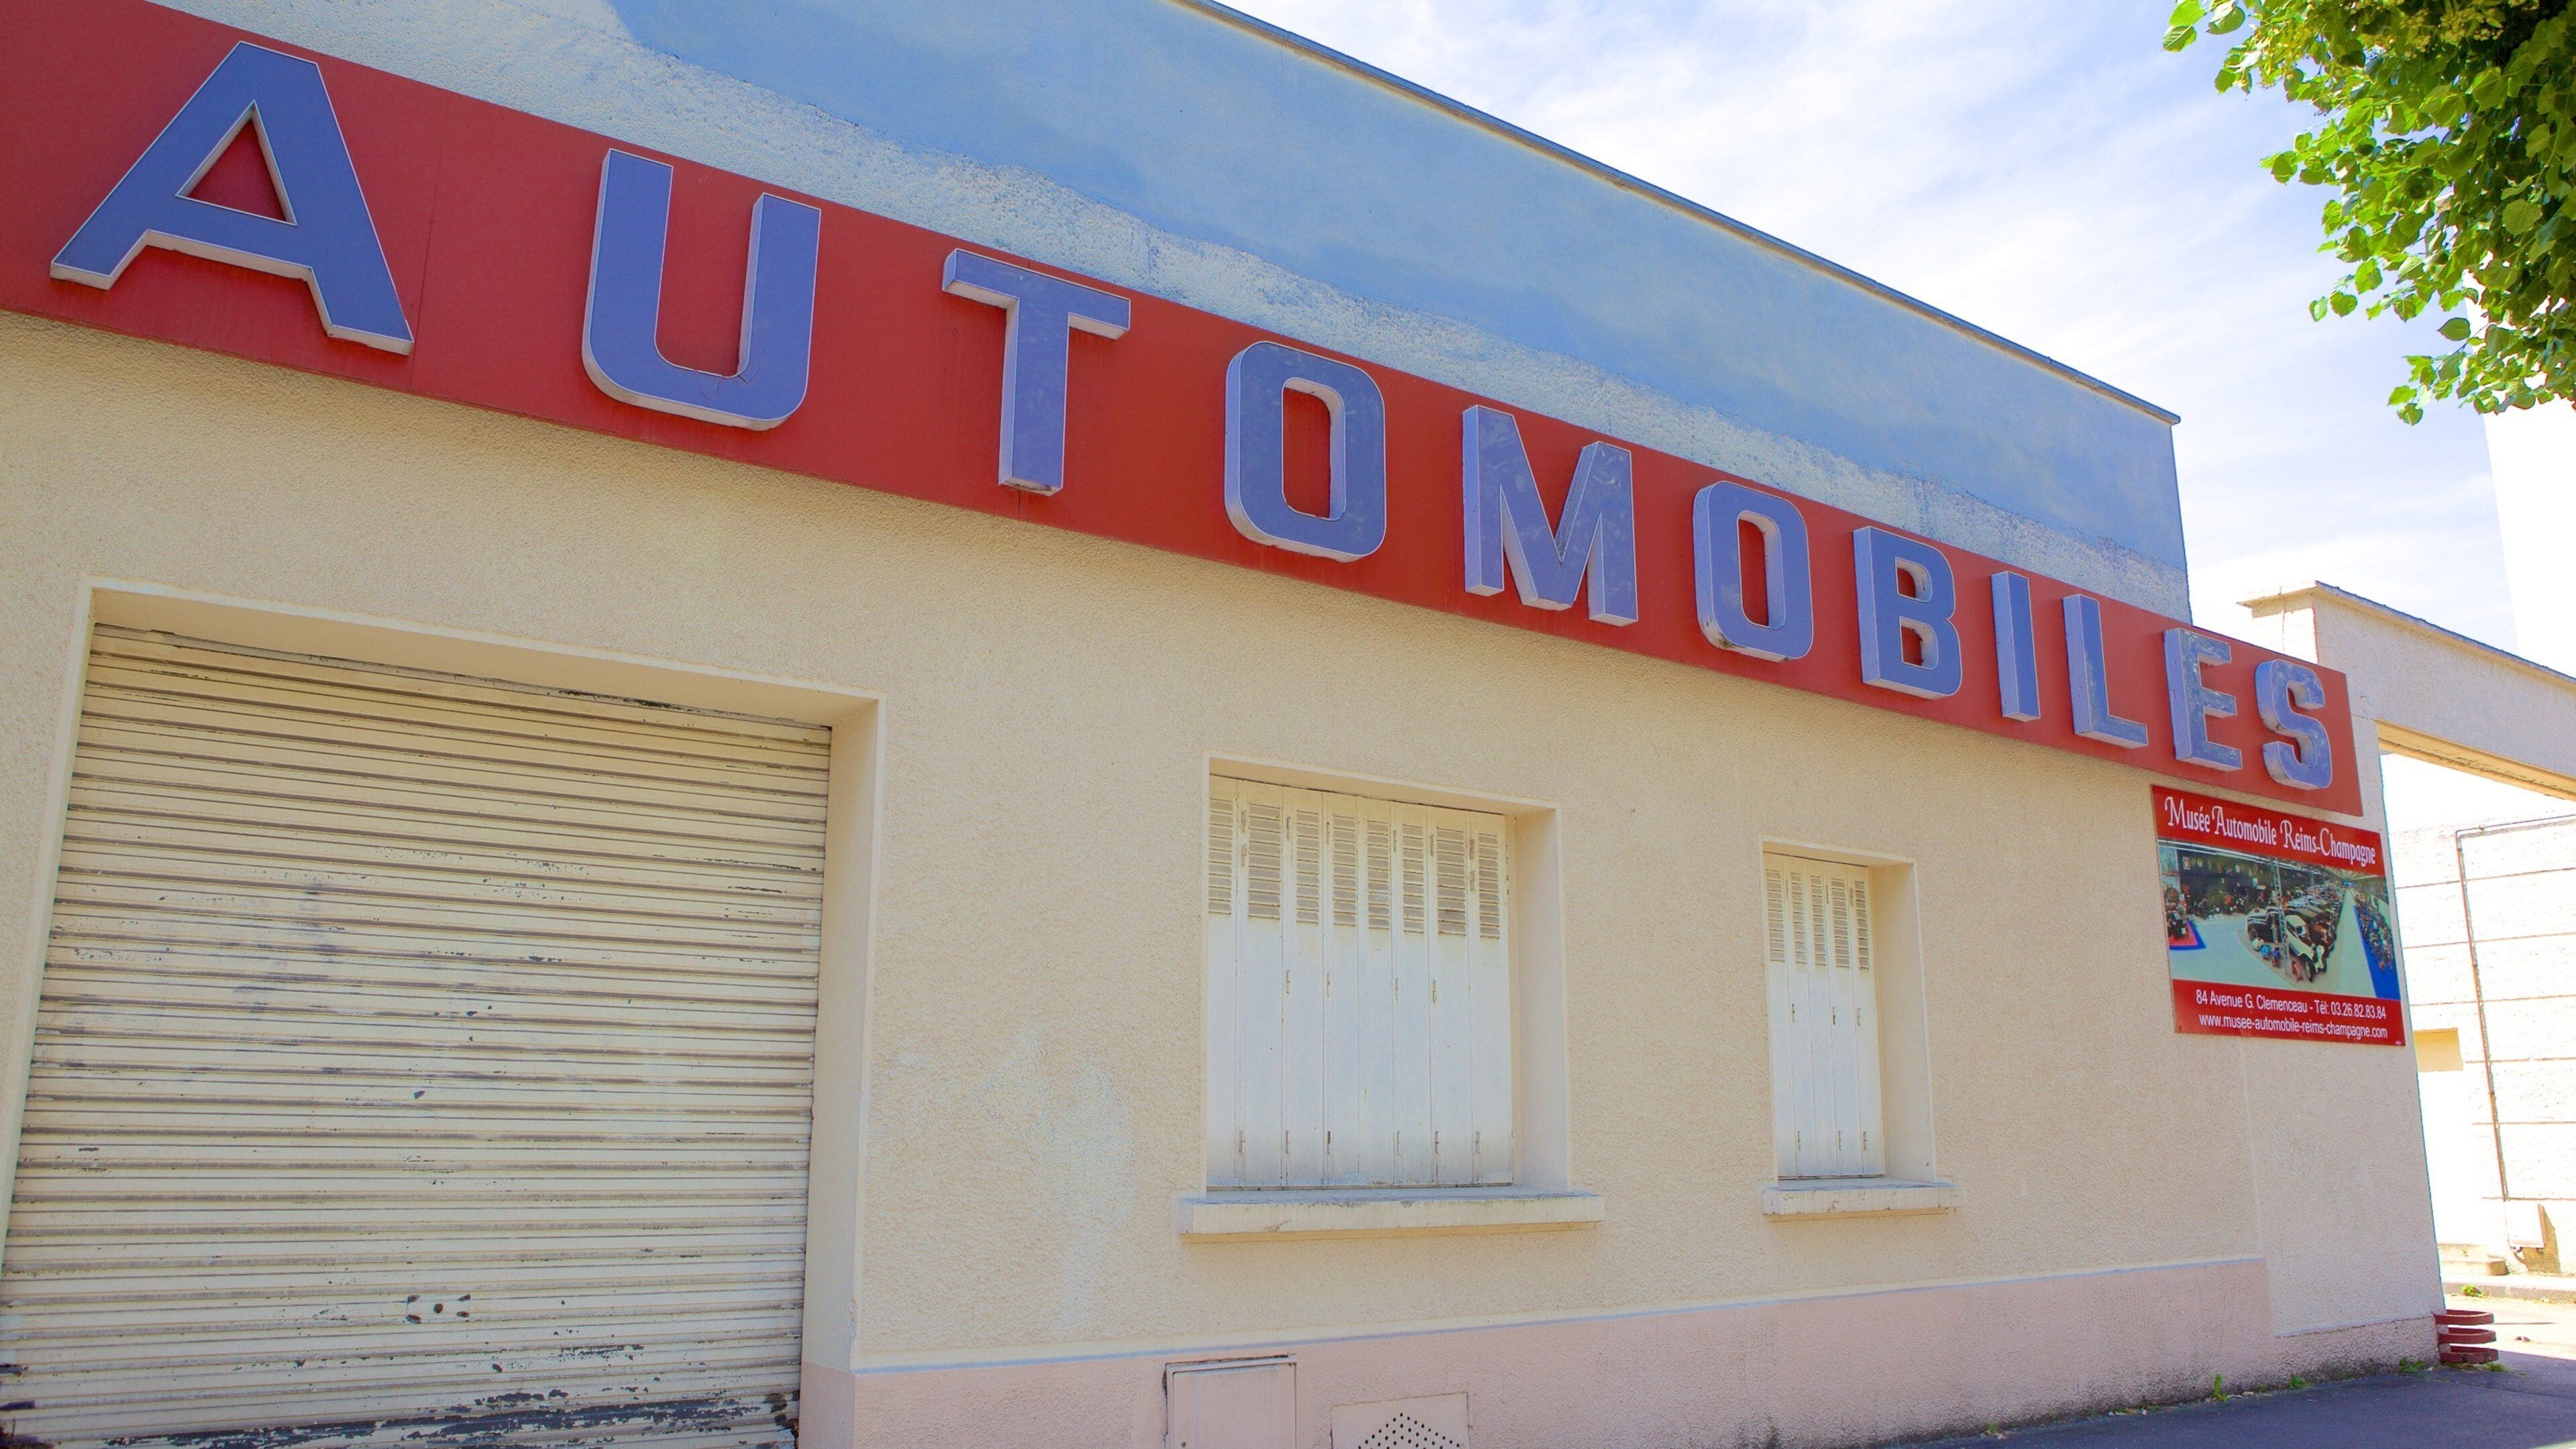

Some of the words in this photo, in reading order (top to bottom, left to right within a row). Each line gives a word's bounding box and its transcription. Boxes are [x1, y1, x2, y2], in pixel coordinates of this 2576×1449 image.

[50, 40, 2332, 790] AUTOMOBILES
[2164, 796, 2210, 833] Musée
[2211, 806, 2277, 845] Automobile
[2279, 820, 2375, 867] Reims-Champagne
[2196, 989, 2208, 1005] 84
[2210, 990, 2243, 1008] Avenue
[2245, 994, 2254, 1009] G.
[2256, 994, 2308, 1013] Clemenceau
[2314, 1000, 2329, 1014] Tél:
[2330, 1002, 2386, 1019] 03.26.82.83.84
[2199, 1014, 2387, 1040] www.musee-automobile-reims-champagne.com
